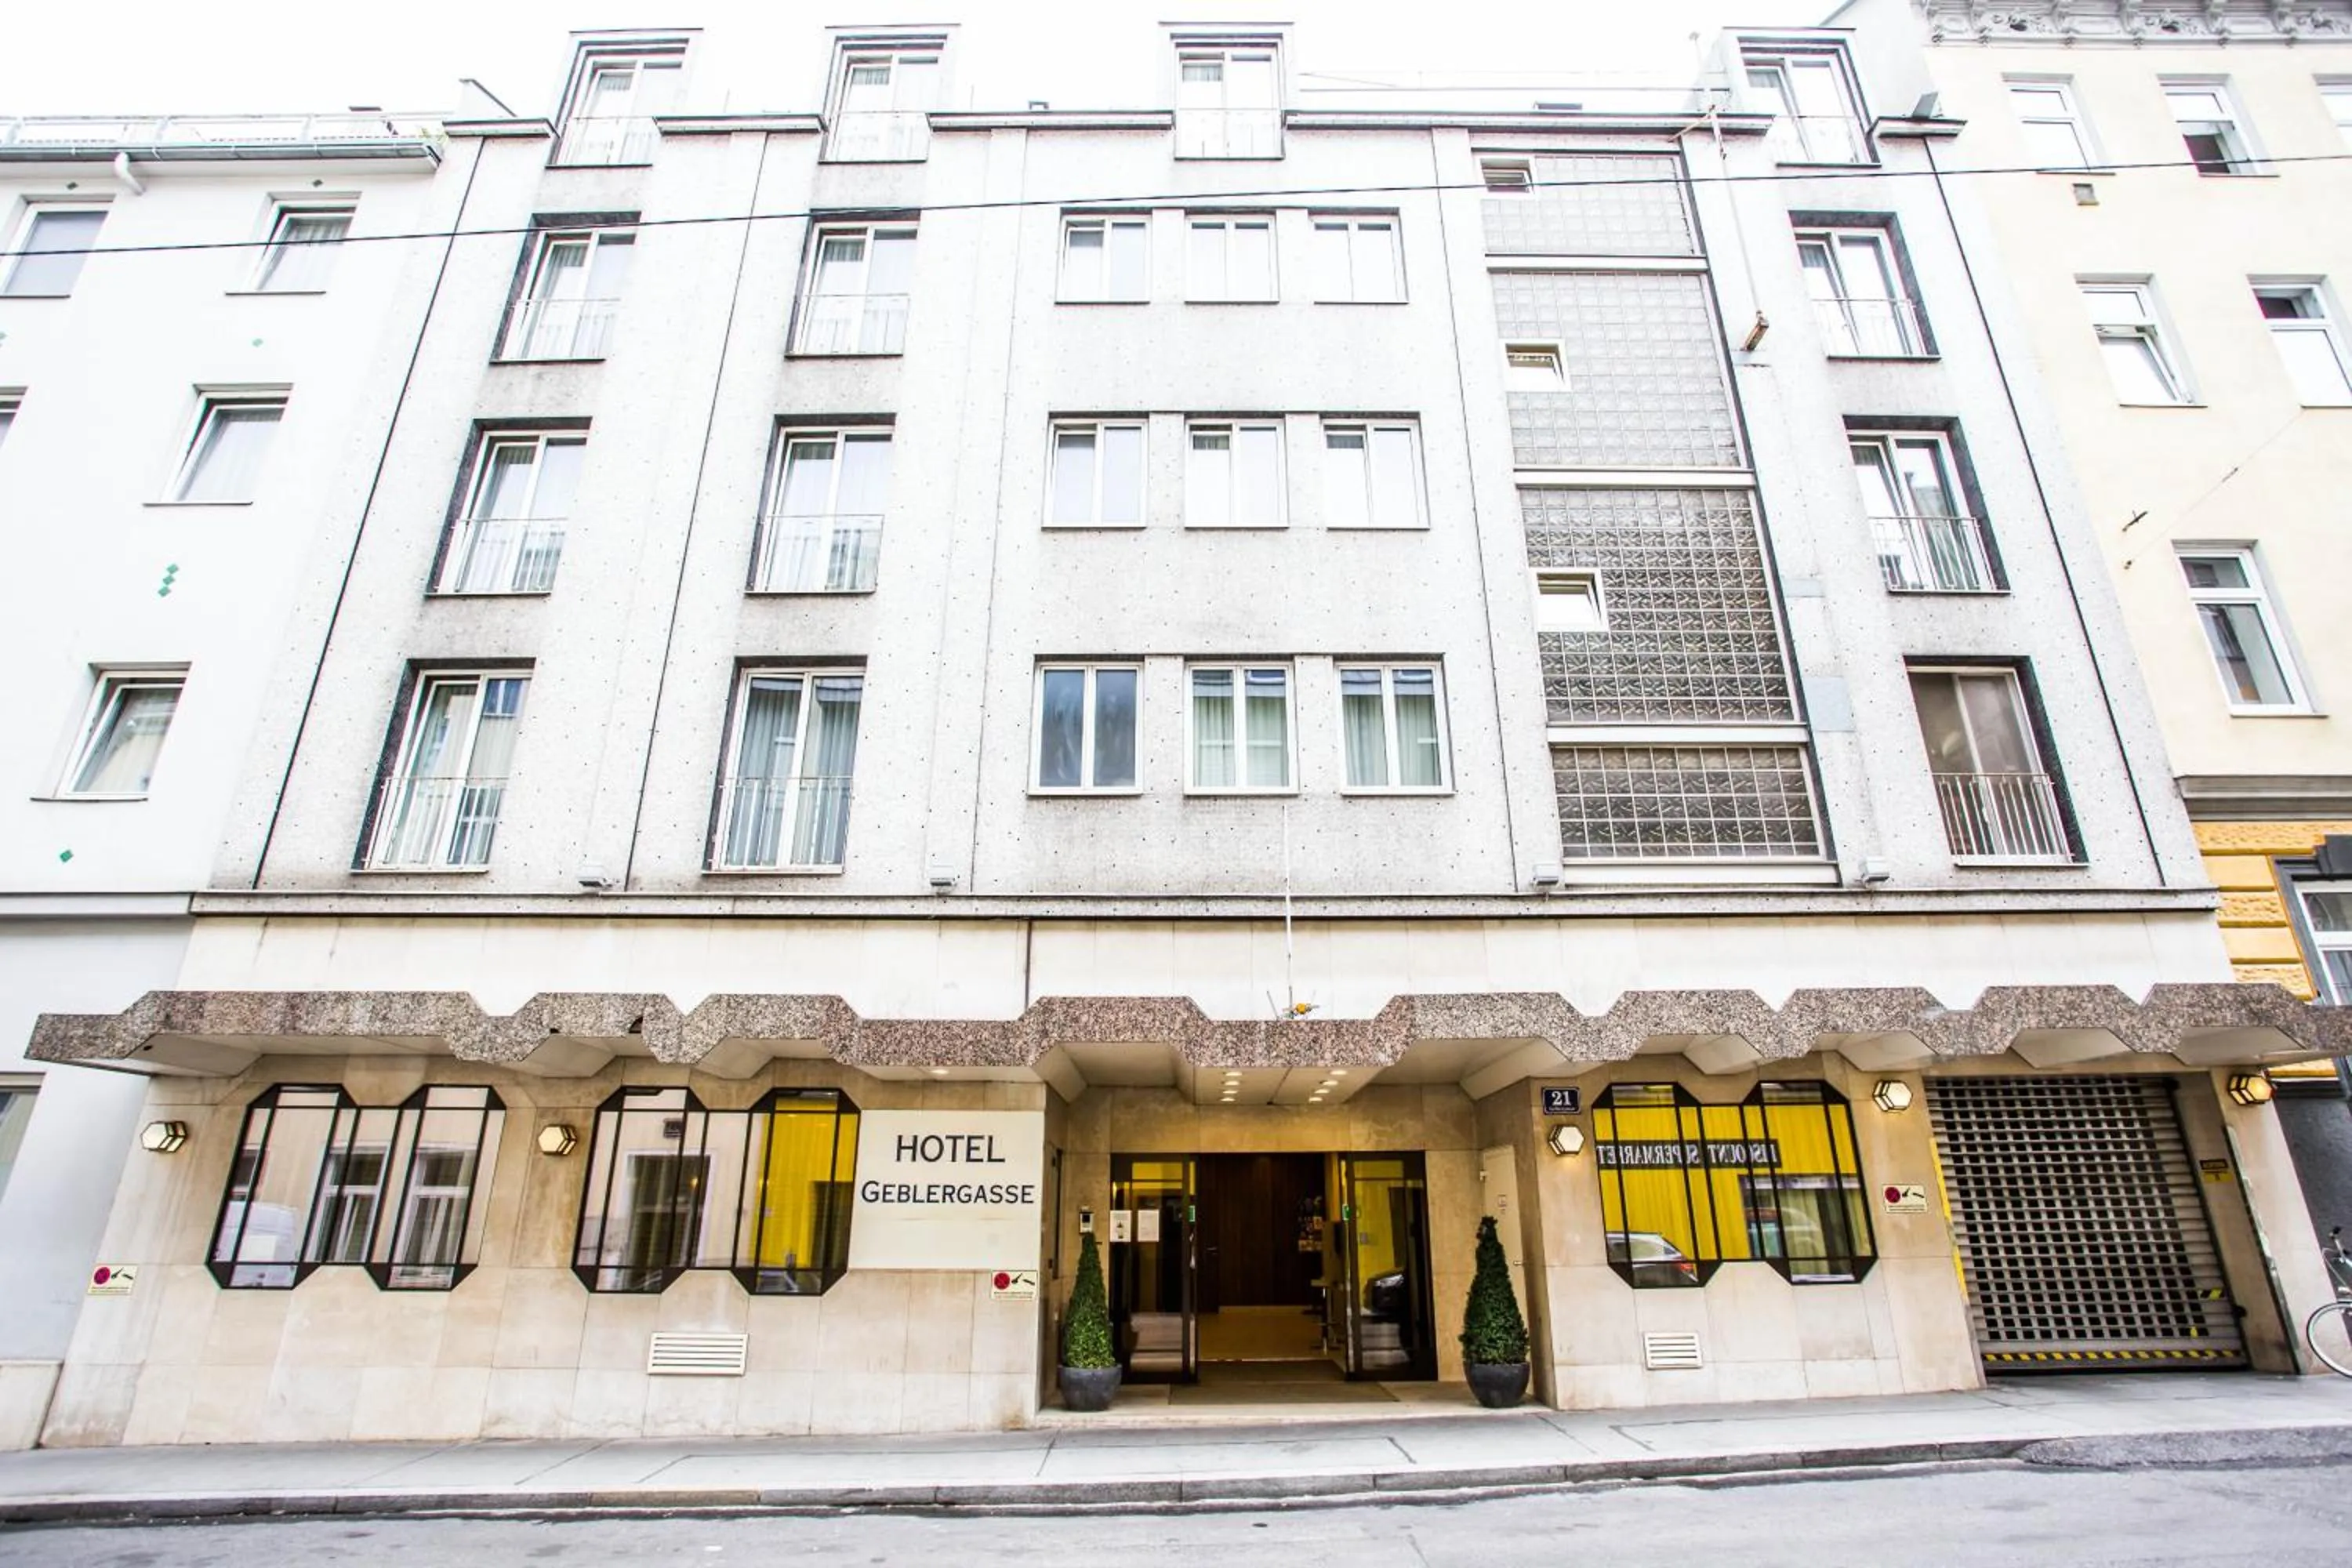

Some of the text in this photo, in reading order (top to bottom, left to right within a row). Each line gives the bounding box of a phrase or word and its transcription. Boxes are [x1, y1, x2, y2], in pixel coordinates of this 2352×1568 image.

[1552, 1091, 1572, 1106] 21
[895, 1134, 1006, 1163] HOTEL
[861, 1180, 1036, 1204] GEBLERGASSE
